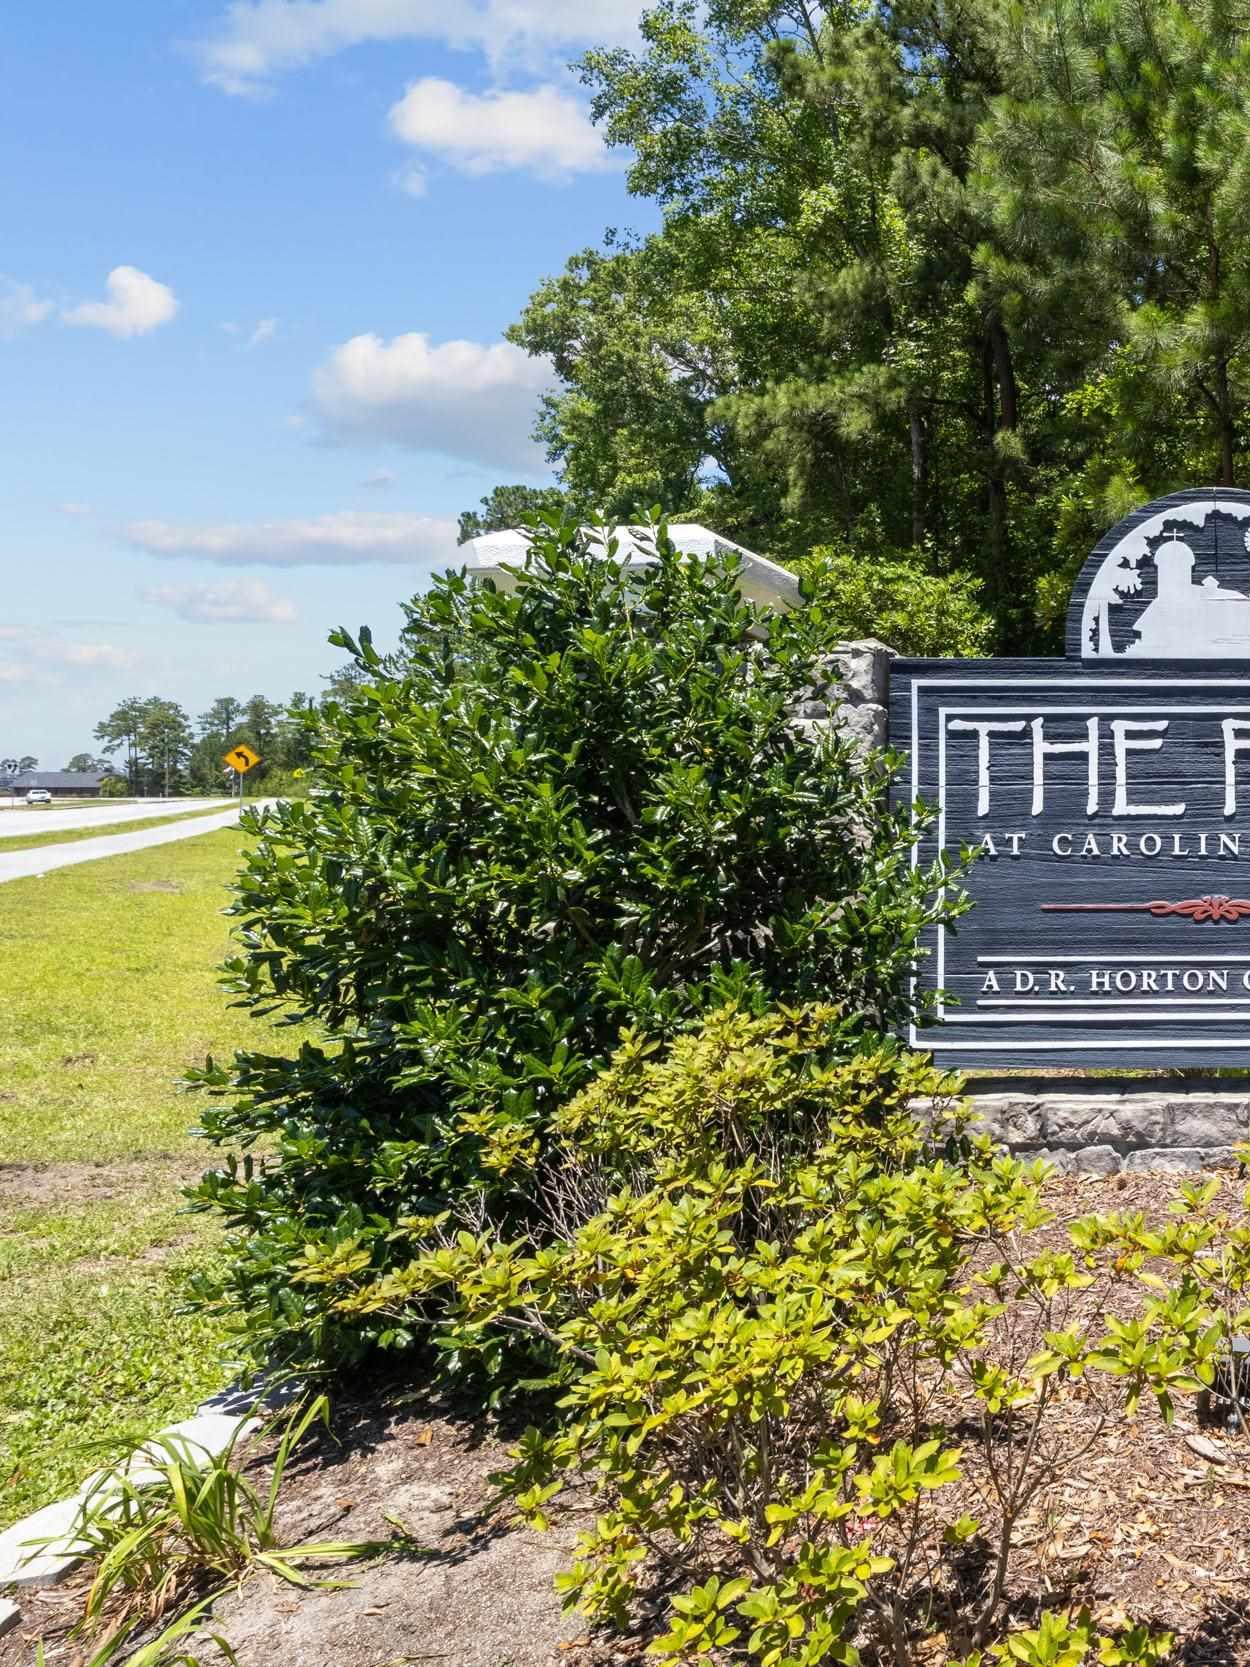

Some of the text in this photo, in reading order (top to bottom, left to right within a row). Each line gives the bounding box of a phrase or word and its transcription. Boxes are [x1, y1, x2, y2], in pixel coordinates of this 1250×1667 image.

[948, 716, 1186, 817] THE
[980, 832, 1026, 856] AT
[980, 970, 1001, 992] A
[1089, 969, 1229, 992] HORTON
